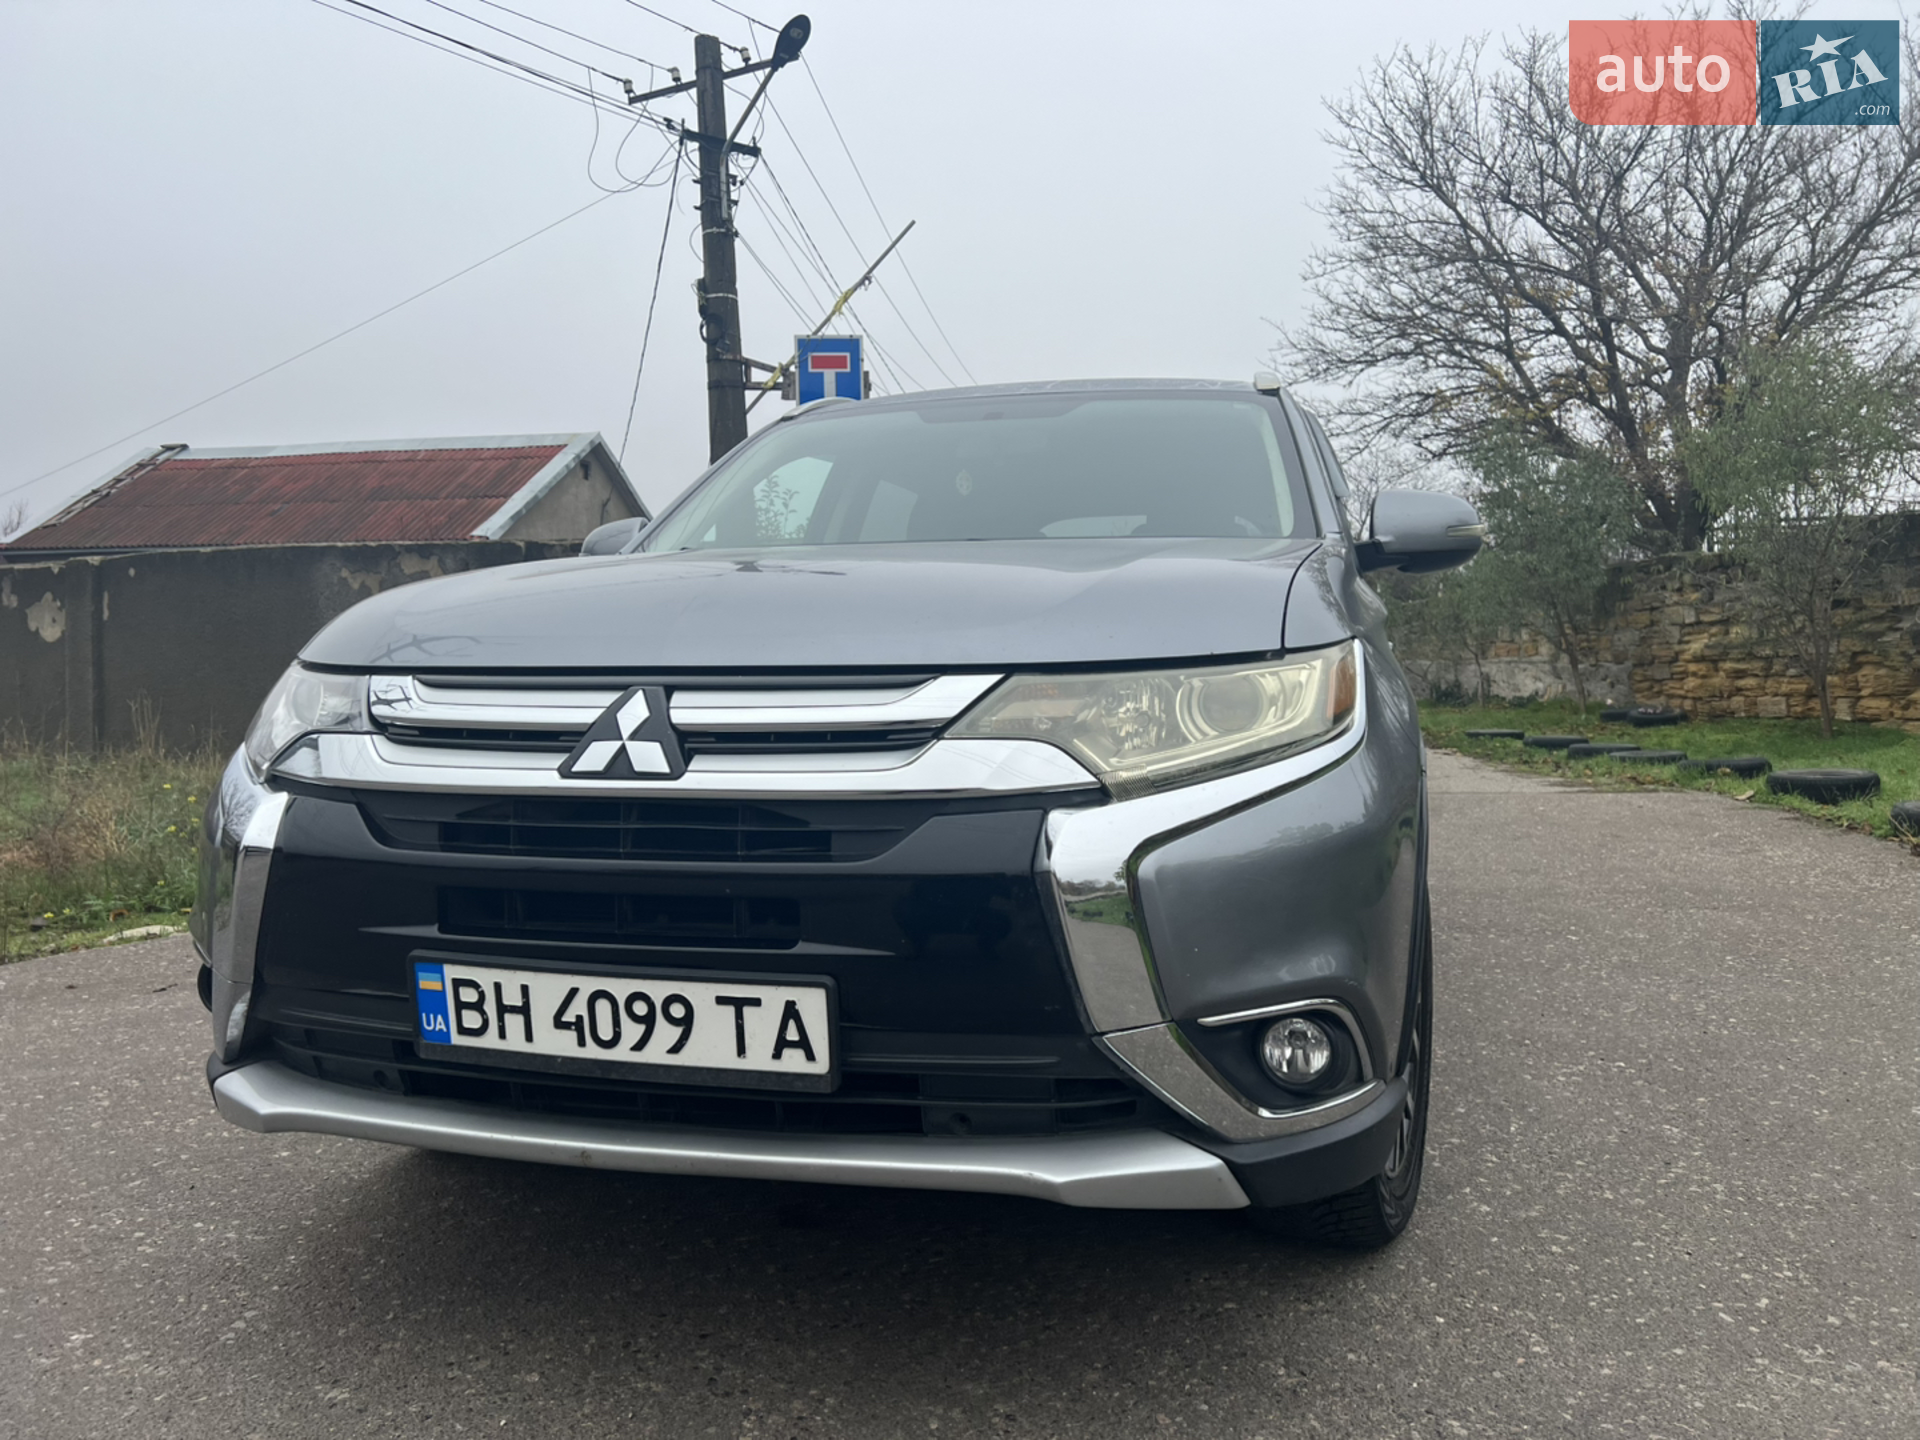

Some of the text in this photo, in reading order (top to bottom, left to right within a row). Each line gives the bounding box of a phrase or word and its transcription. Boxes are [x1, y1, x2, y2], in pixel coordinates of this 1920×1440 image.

[421, 1012, 448, 1033] UA
[451, 977, 817, 1062] BH 4099 TA
